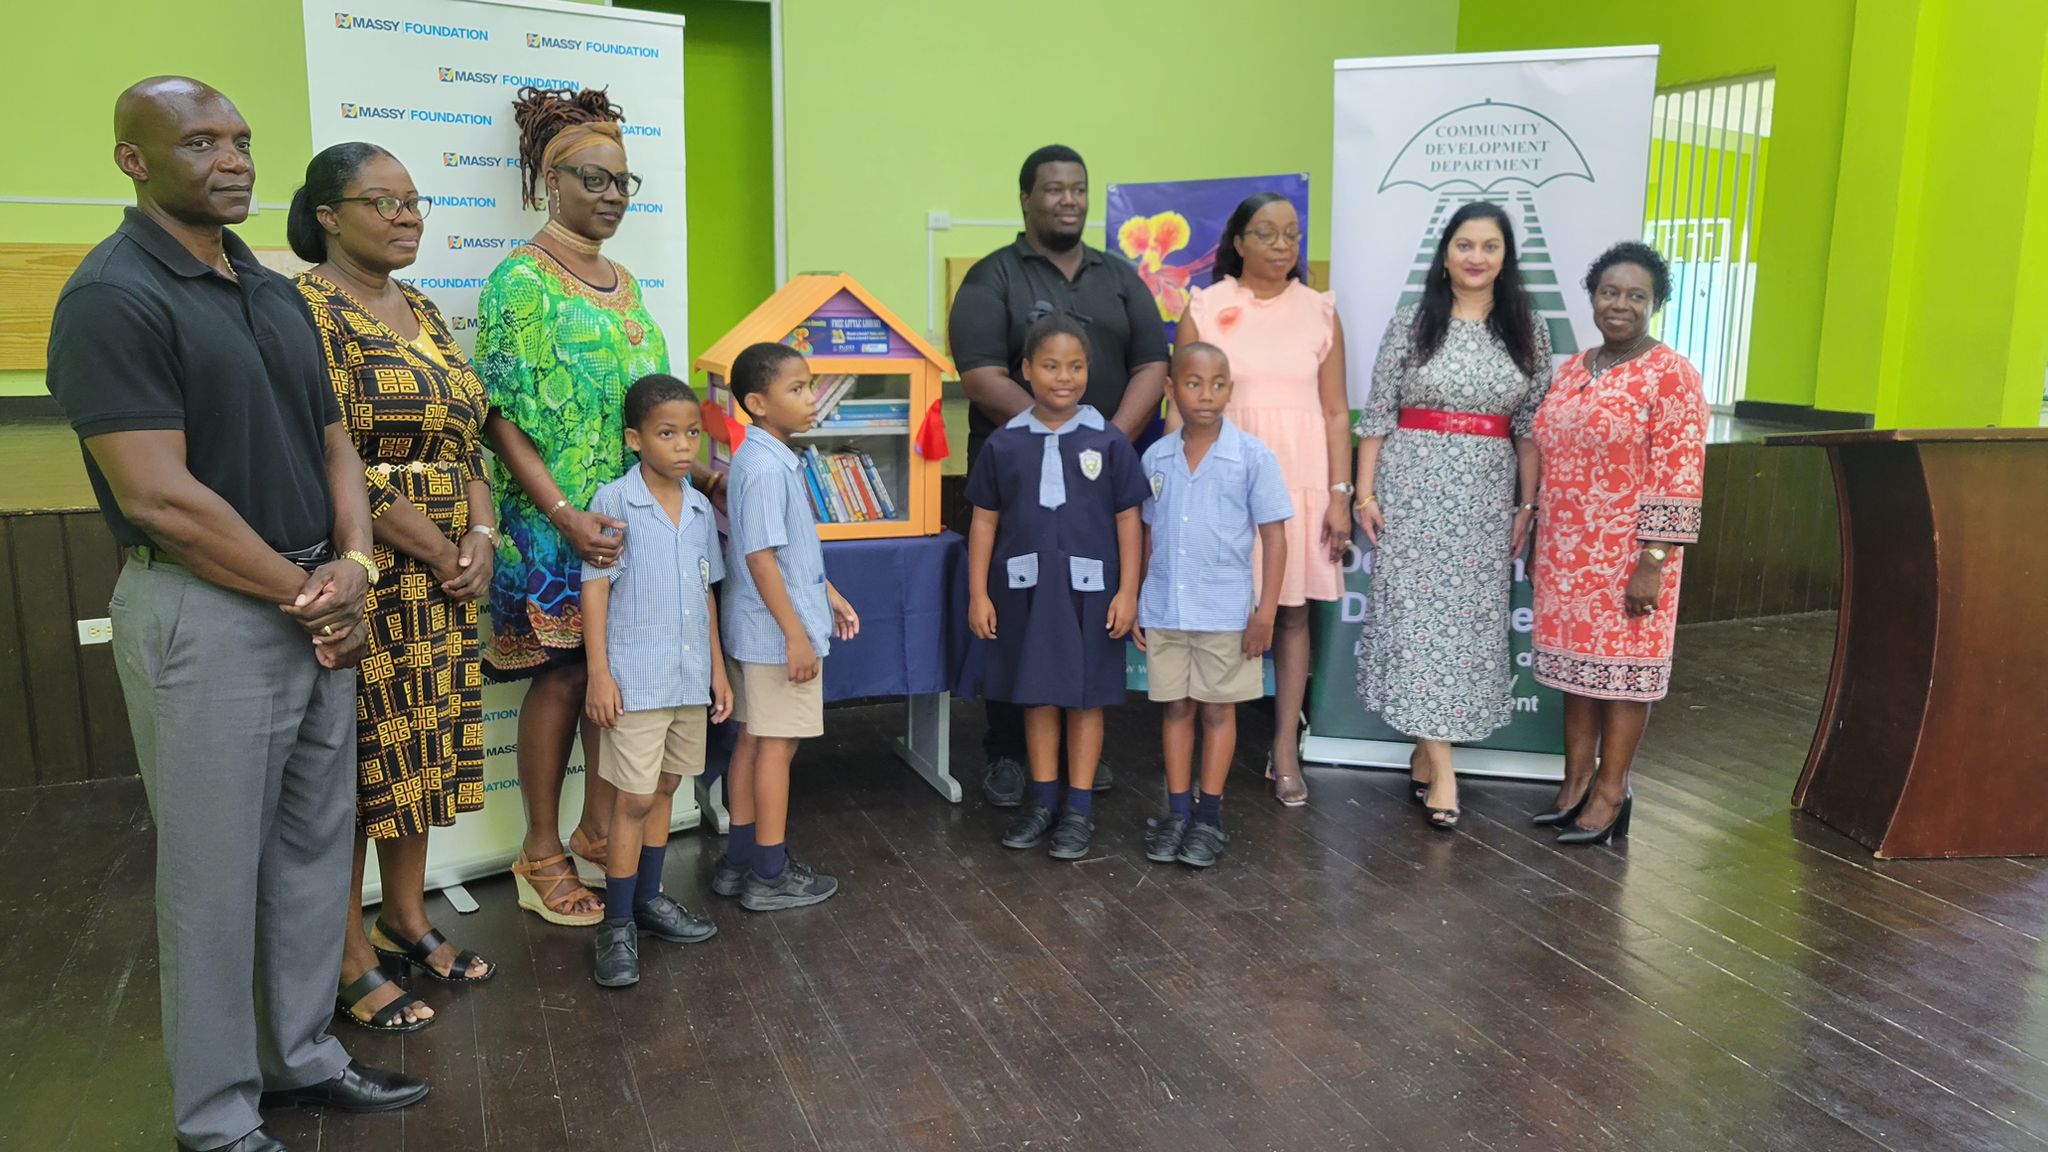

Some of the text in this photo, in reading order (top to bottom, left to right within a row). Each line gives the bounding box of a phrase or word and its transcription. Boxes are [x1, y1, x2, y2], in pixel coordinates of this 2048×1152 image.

[352, 17, 489, 41] MASSY FOUNDATION
[541, 36, 660, 58] MASSY FOUNDATION
[455, 70, 580, 91] MASSY FOUNDATION
[359, 106, 492, 126] MASSY FOUNDATION
[1435, 123, 1541, 137] COMMUNITY
[1425, 140, 1551, 155] DEVELOPMENT
[459, 155, 502, 167] MASSY
[1431, 159, 1543, 172] DEPARTMENT
[464, 238, 506, 249] MASSY
